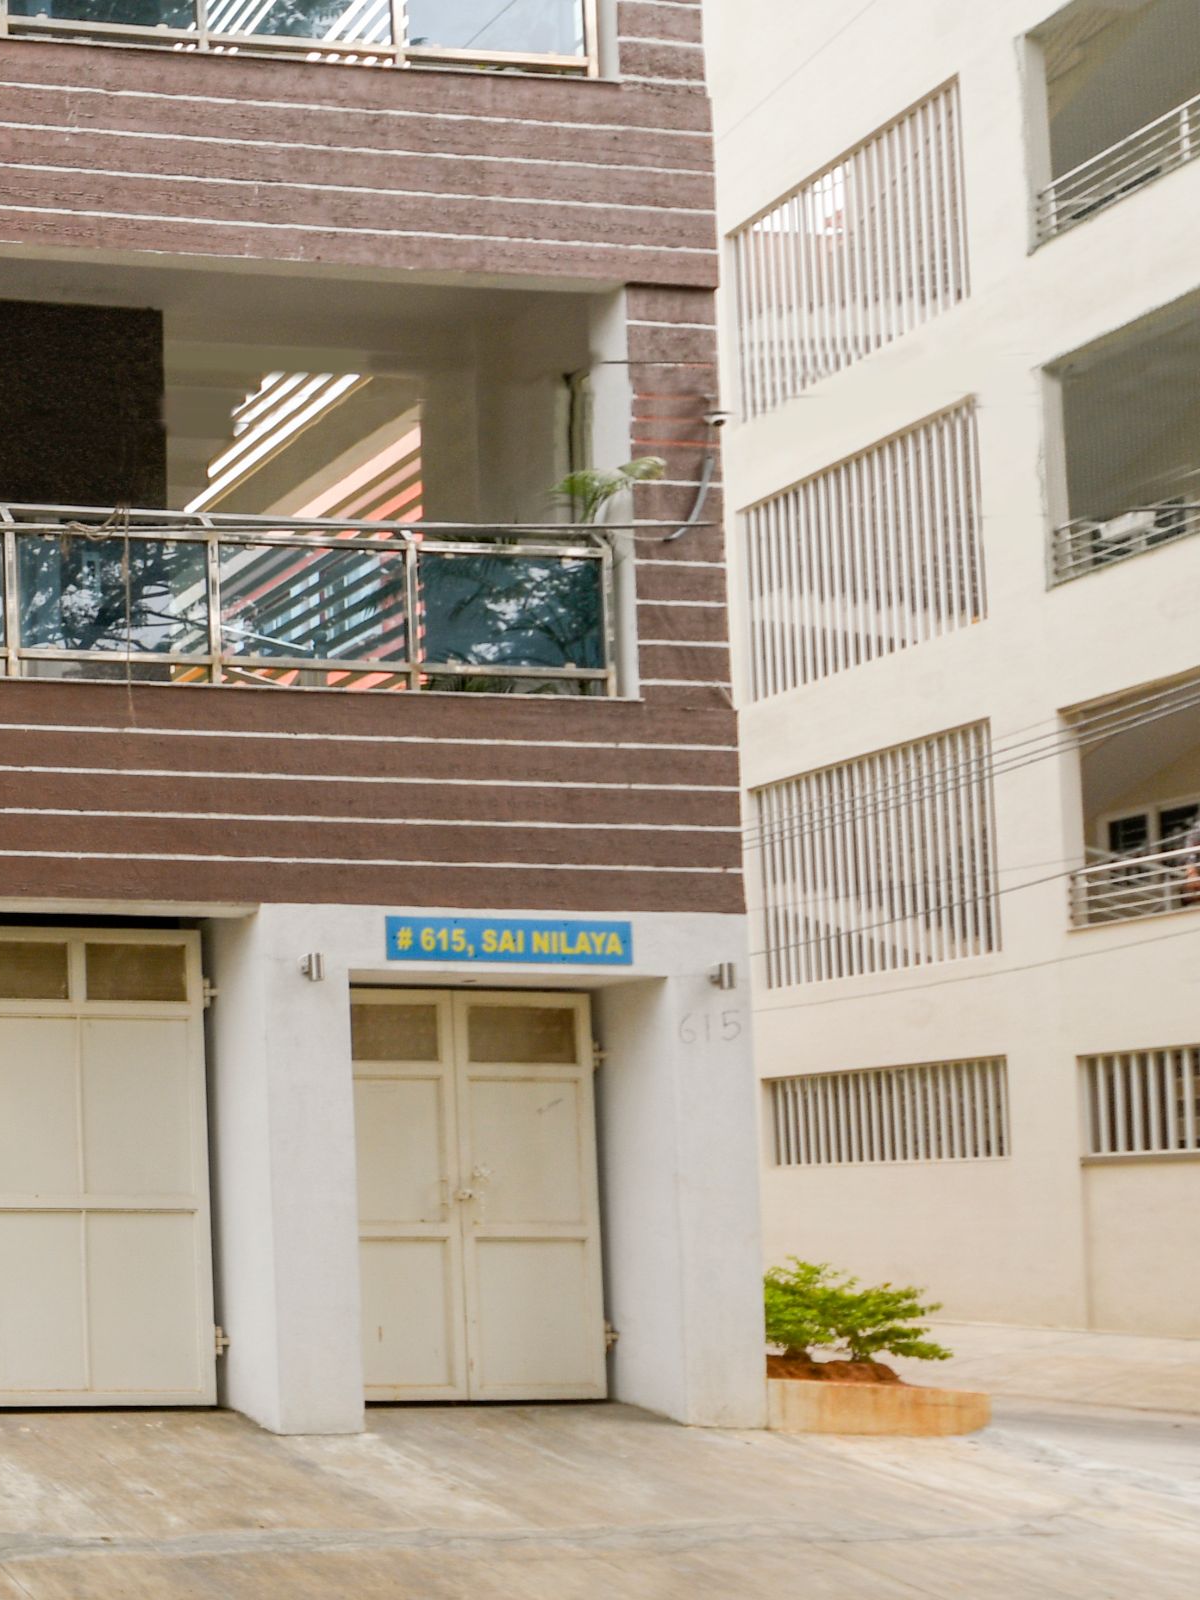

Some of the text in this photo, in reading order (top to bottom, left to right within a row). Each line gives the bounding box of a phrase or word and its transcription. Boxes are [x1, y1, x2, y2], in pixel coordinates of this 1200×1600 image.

[397, 927, 624, 957] # 615, SAI NILAYA
[679, 1010, 742, 1045] 615
